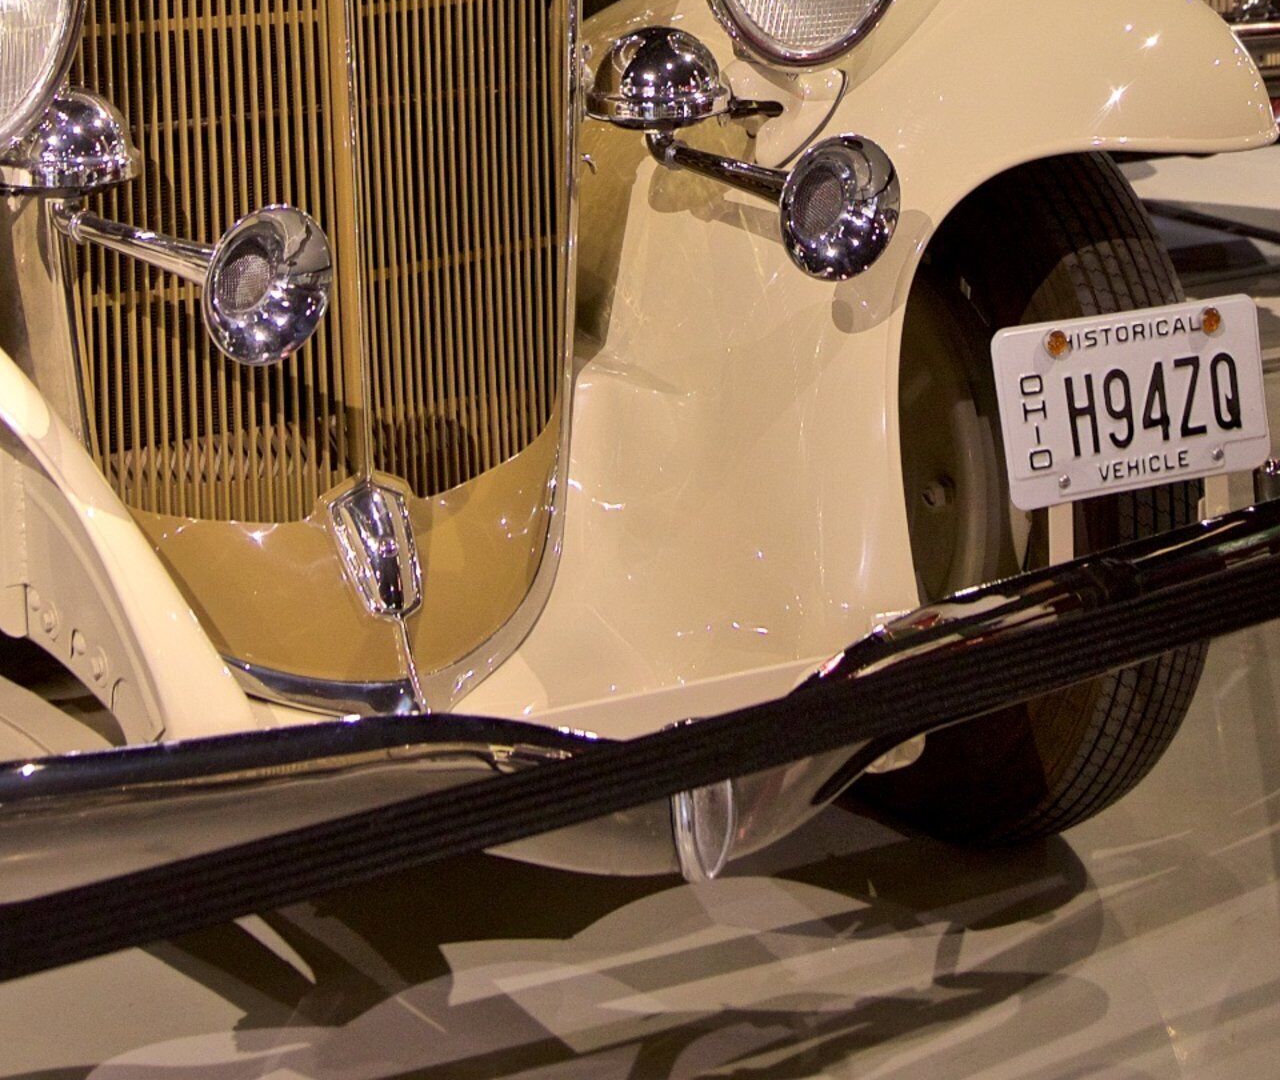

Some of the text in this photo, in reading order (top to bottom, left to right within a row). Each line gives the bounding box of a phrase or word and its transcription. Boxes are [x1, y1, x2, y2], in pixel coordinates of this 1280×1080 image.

[1019, 373, 1054, 471] OHIO
[1064, 351, 1243, 458] H94ZQ
[1098, 449, 1190, 482] VEHICLE
